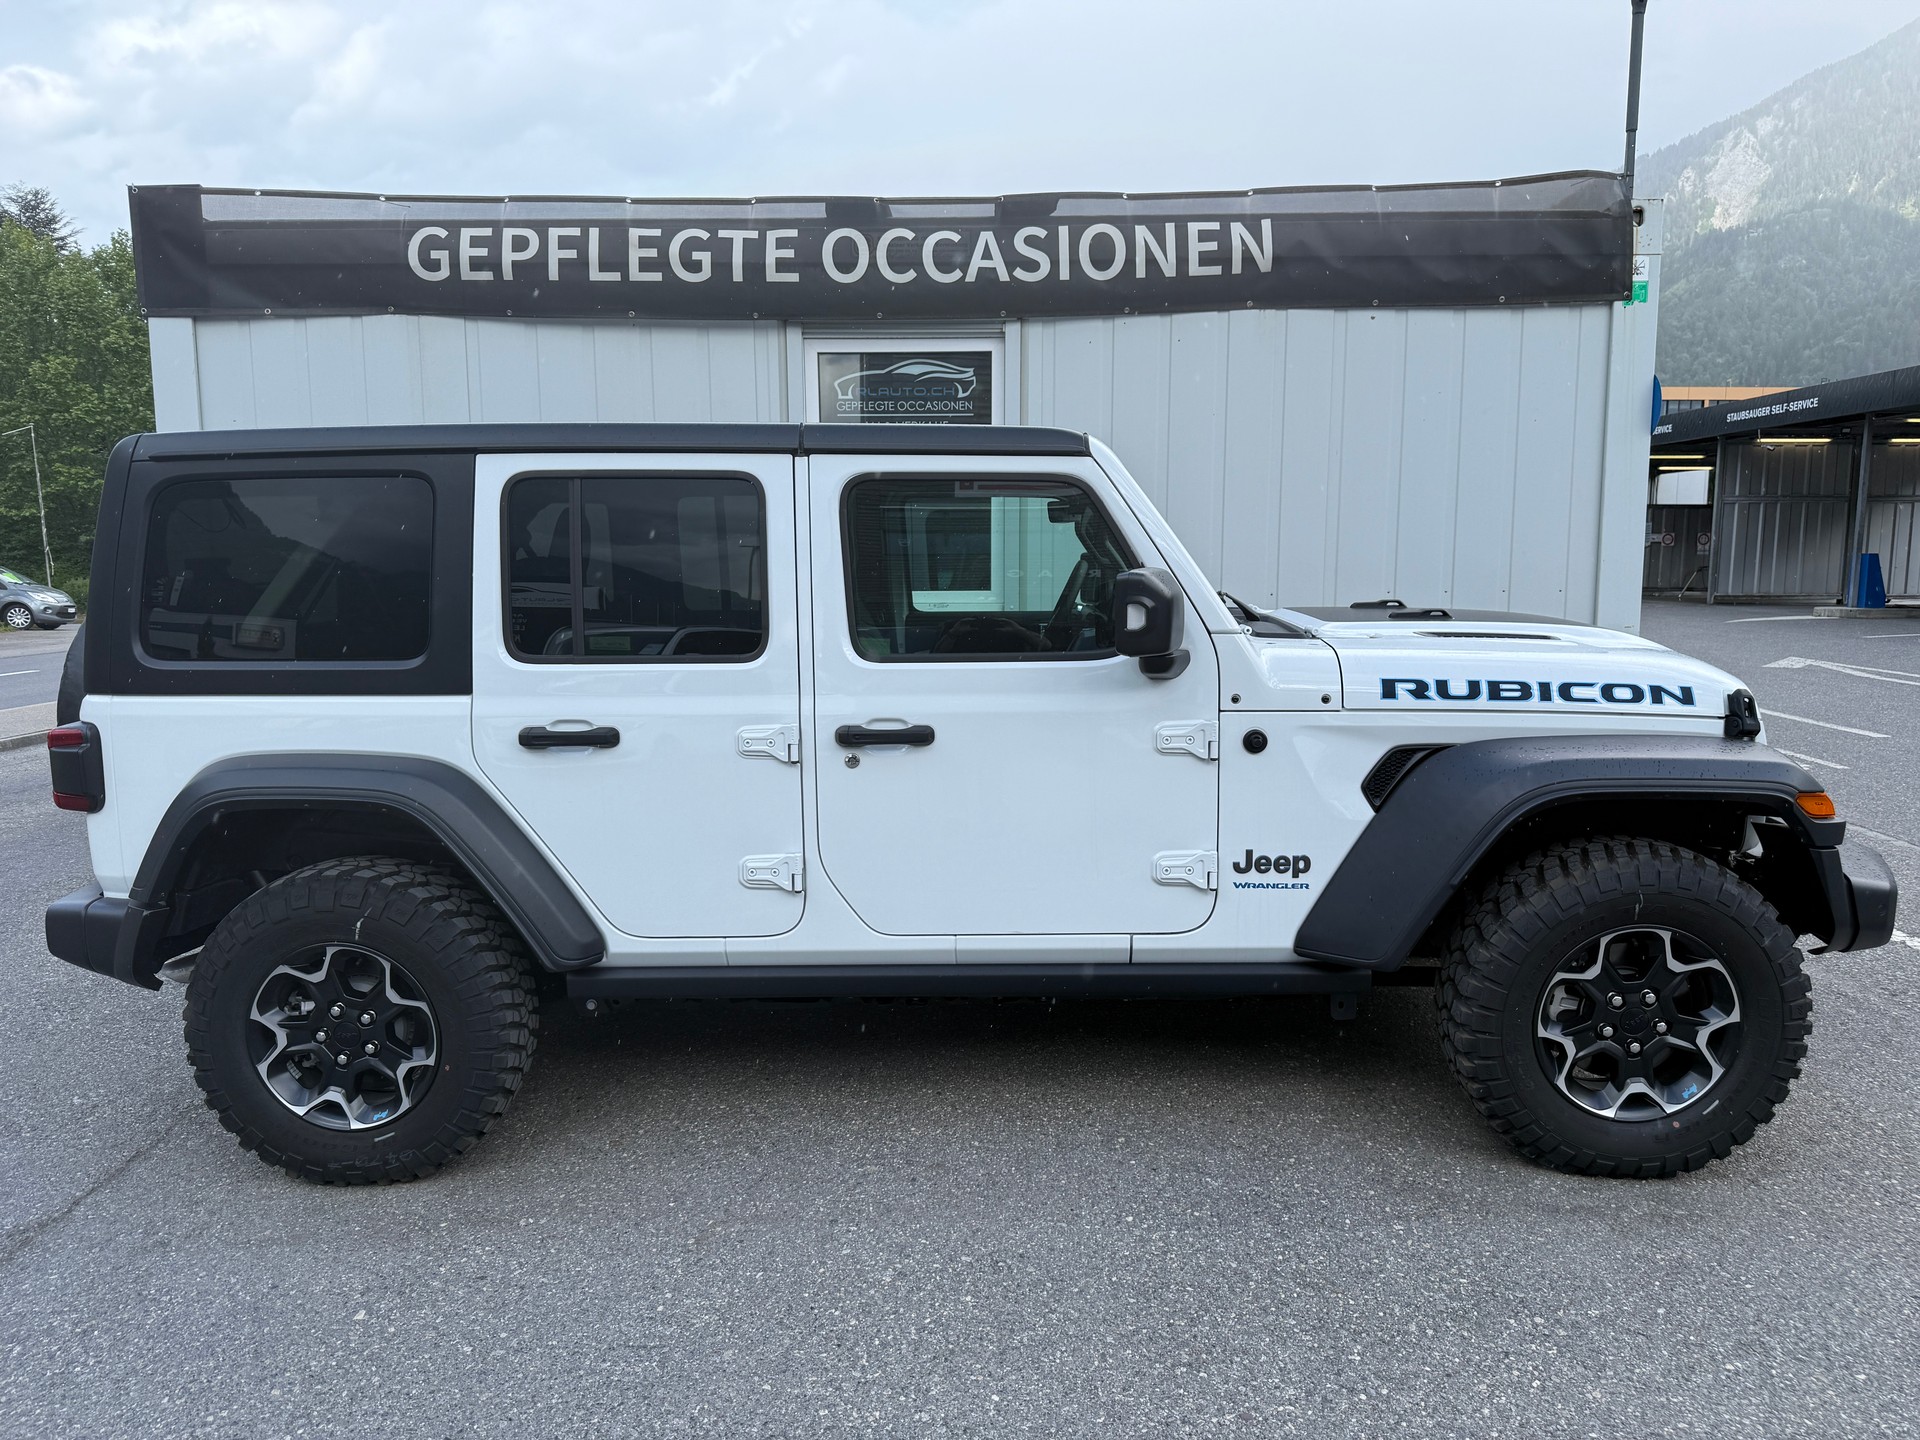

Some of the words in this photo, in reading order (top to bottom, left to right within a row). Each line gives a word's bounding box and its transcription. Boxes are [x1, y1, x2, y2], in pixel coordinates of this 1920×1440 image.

[407, 226, 800, 283] GEPFLEGTE
[821, 218, 1274, 284] OCCASIONEN
[836, 400, 895, 411] GEPFLEGTE
[897, 400, 973, 411] OCCASIONEN
[1726, 406, 1771, 423] STAUBSAUGER
[1771, 397, 1819, 415] SELF-SERVICE
[1652, 423, 1673, 436] ERVICE
[1379, 677, 1697, 707] RUBICON
[1232, 848, 1312, 879] Jeep
[1232, 881, 1310, 890] WRANGLER
